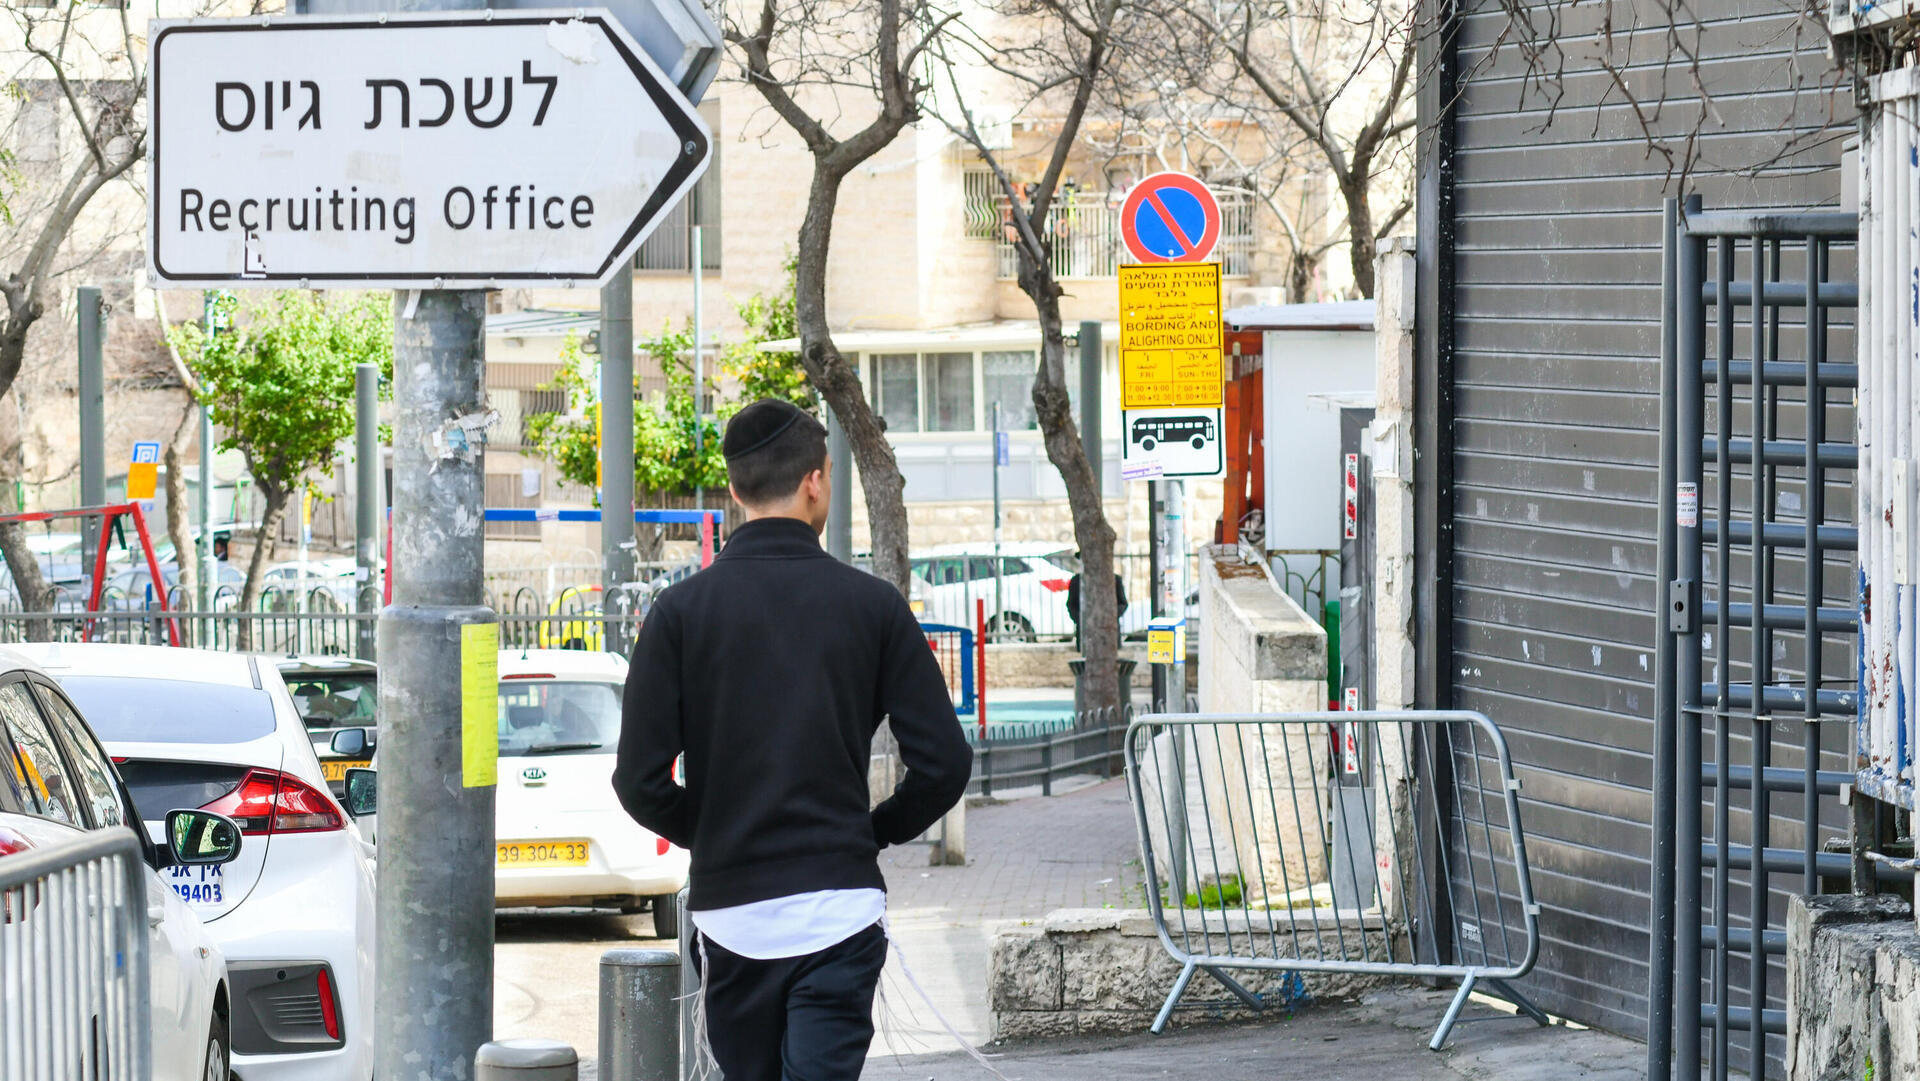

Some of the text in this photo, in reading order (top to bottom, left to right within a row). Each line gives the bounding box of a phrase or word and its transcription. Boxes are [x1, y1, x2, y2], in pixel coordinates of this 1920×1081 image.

[215, 60, 559, 133] לשכת גיוס
[180, 184, 595, 245] Recruiting Office
[1124, 271, 1168, 280] העלאה
[1125, 281, 1166, 290] נוסעים
[1154, 289, 1187, 298] בלבד
[1126, 320, 1217, 332] BORDING AND
[1129, 333, 1214, 346] ALIGHTING ONLY
[525, 768, 544, 779] KIA
